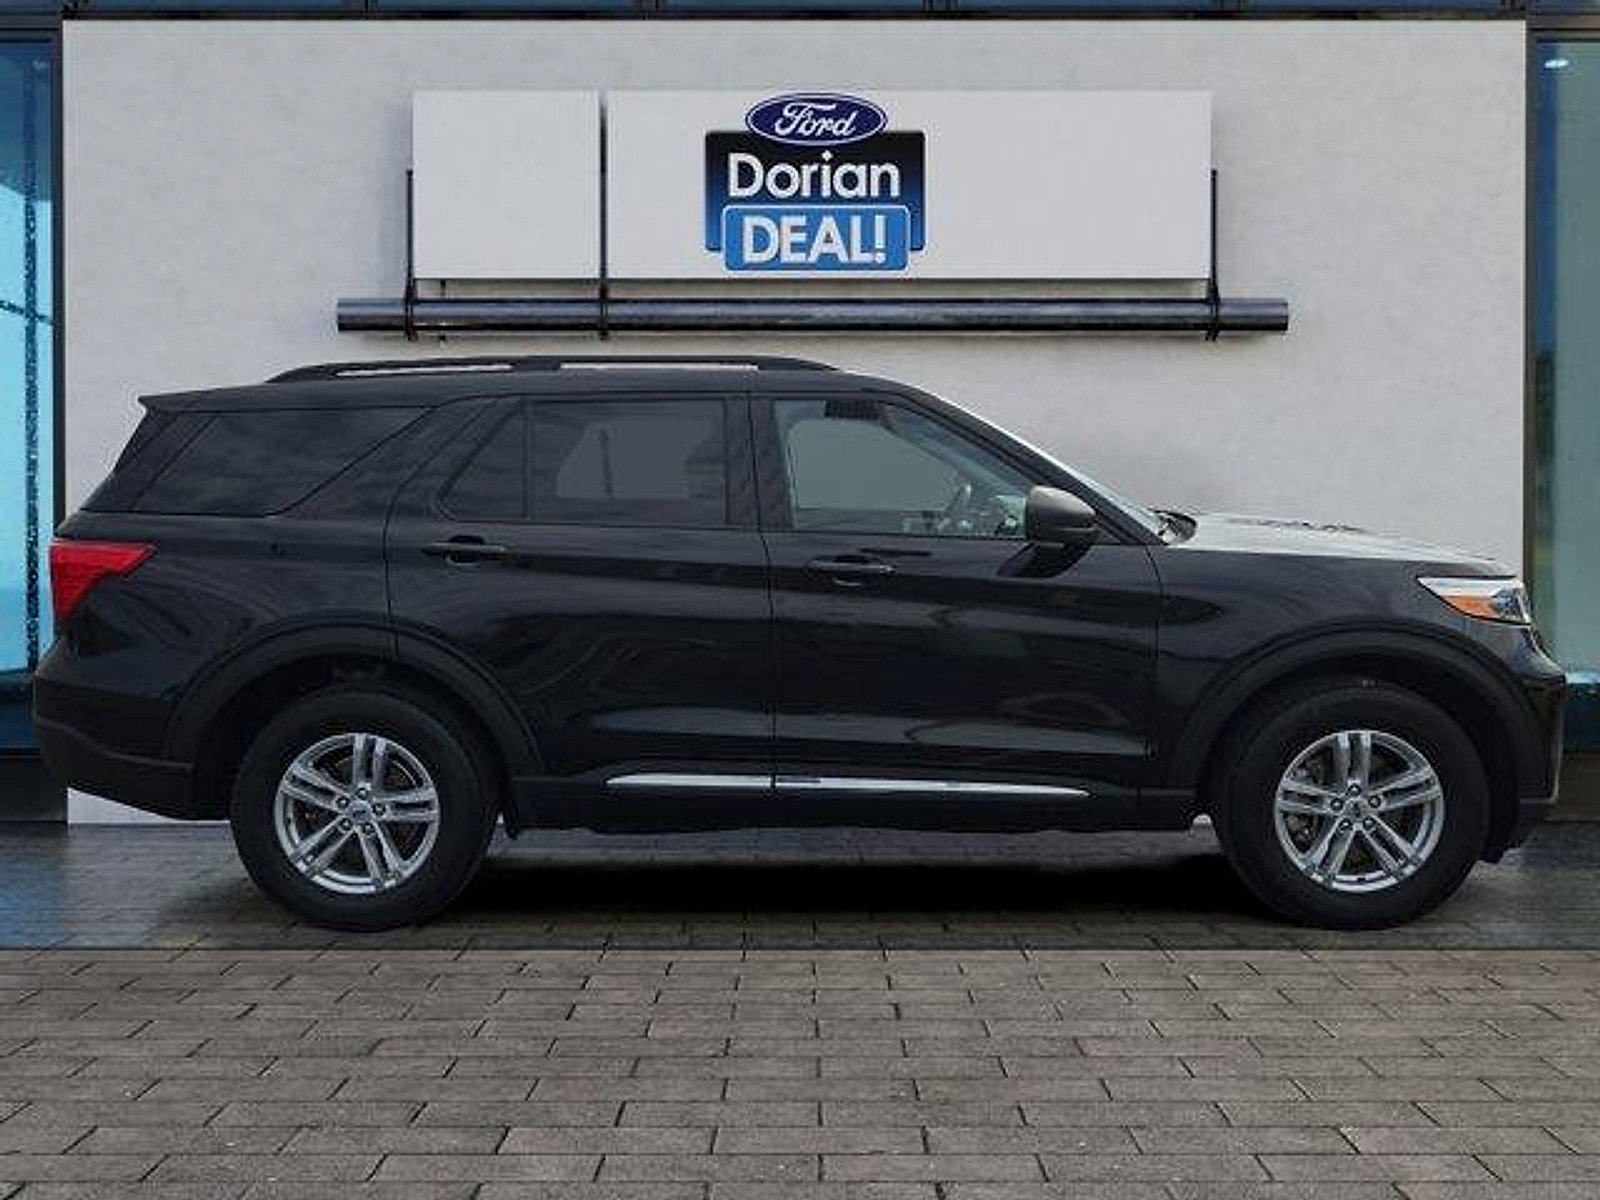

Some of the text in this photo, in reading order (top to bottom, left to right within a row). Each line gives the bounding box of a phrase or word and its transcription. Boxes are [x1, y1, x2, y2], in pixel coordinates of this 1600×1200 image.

[774, 101, 857, 137] Ford
[727, 149, 900, 198] Dorian
[742, 214, 887, 264] DEAL!
